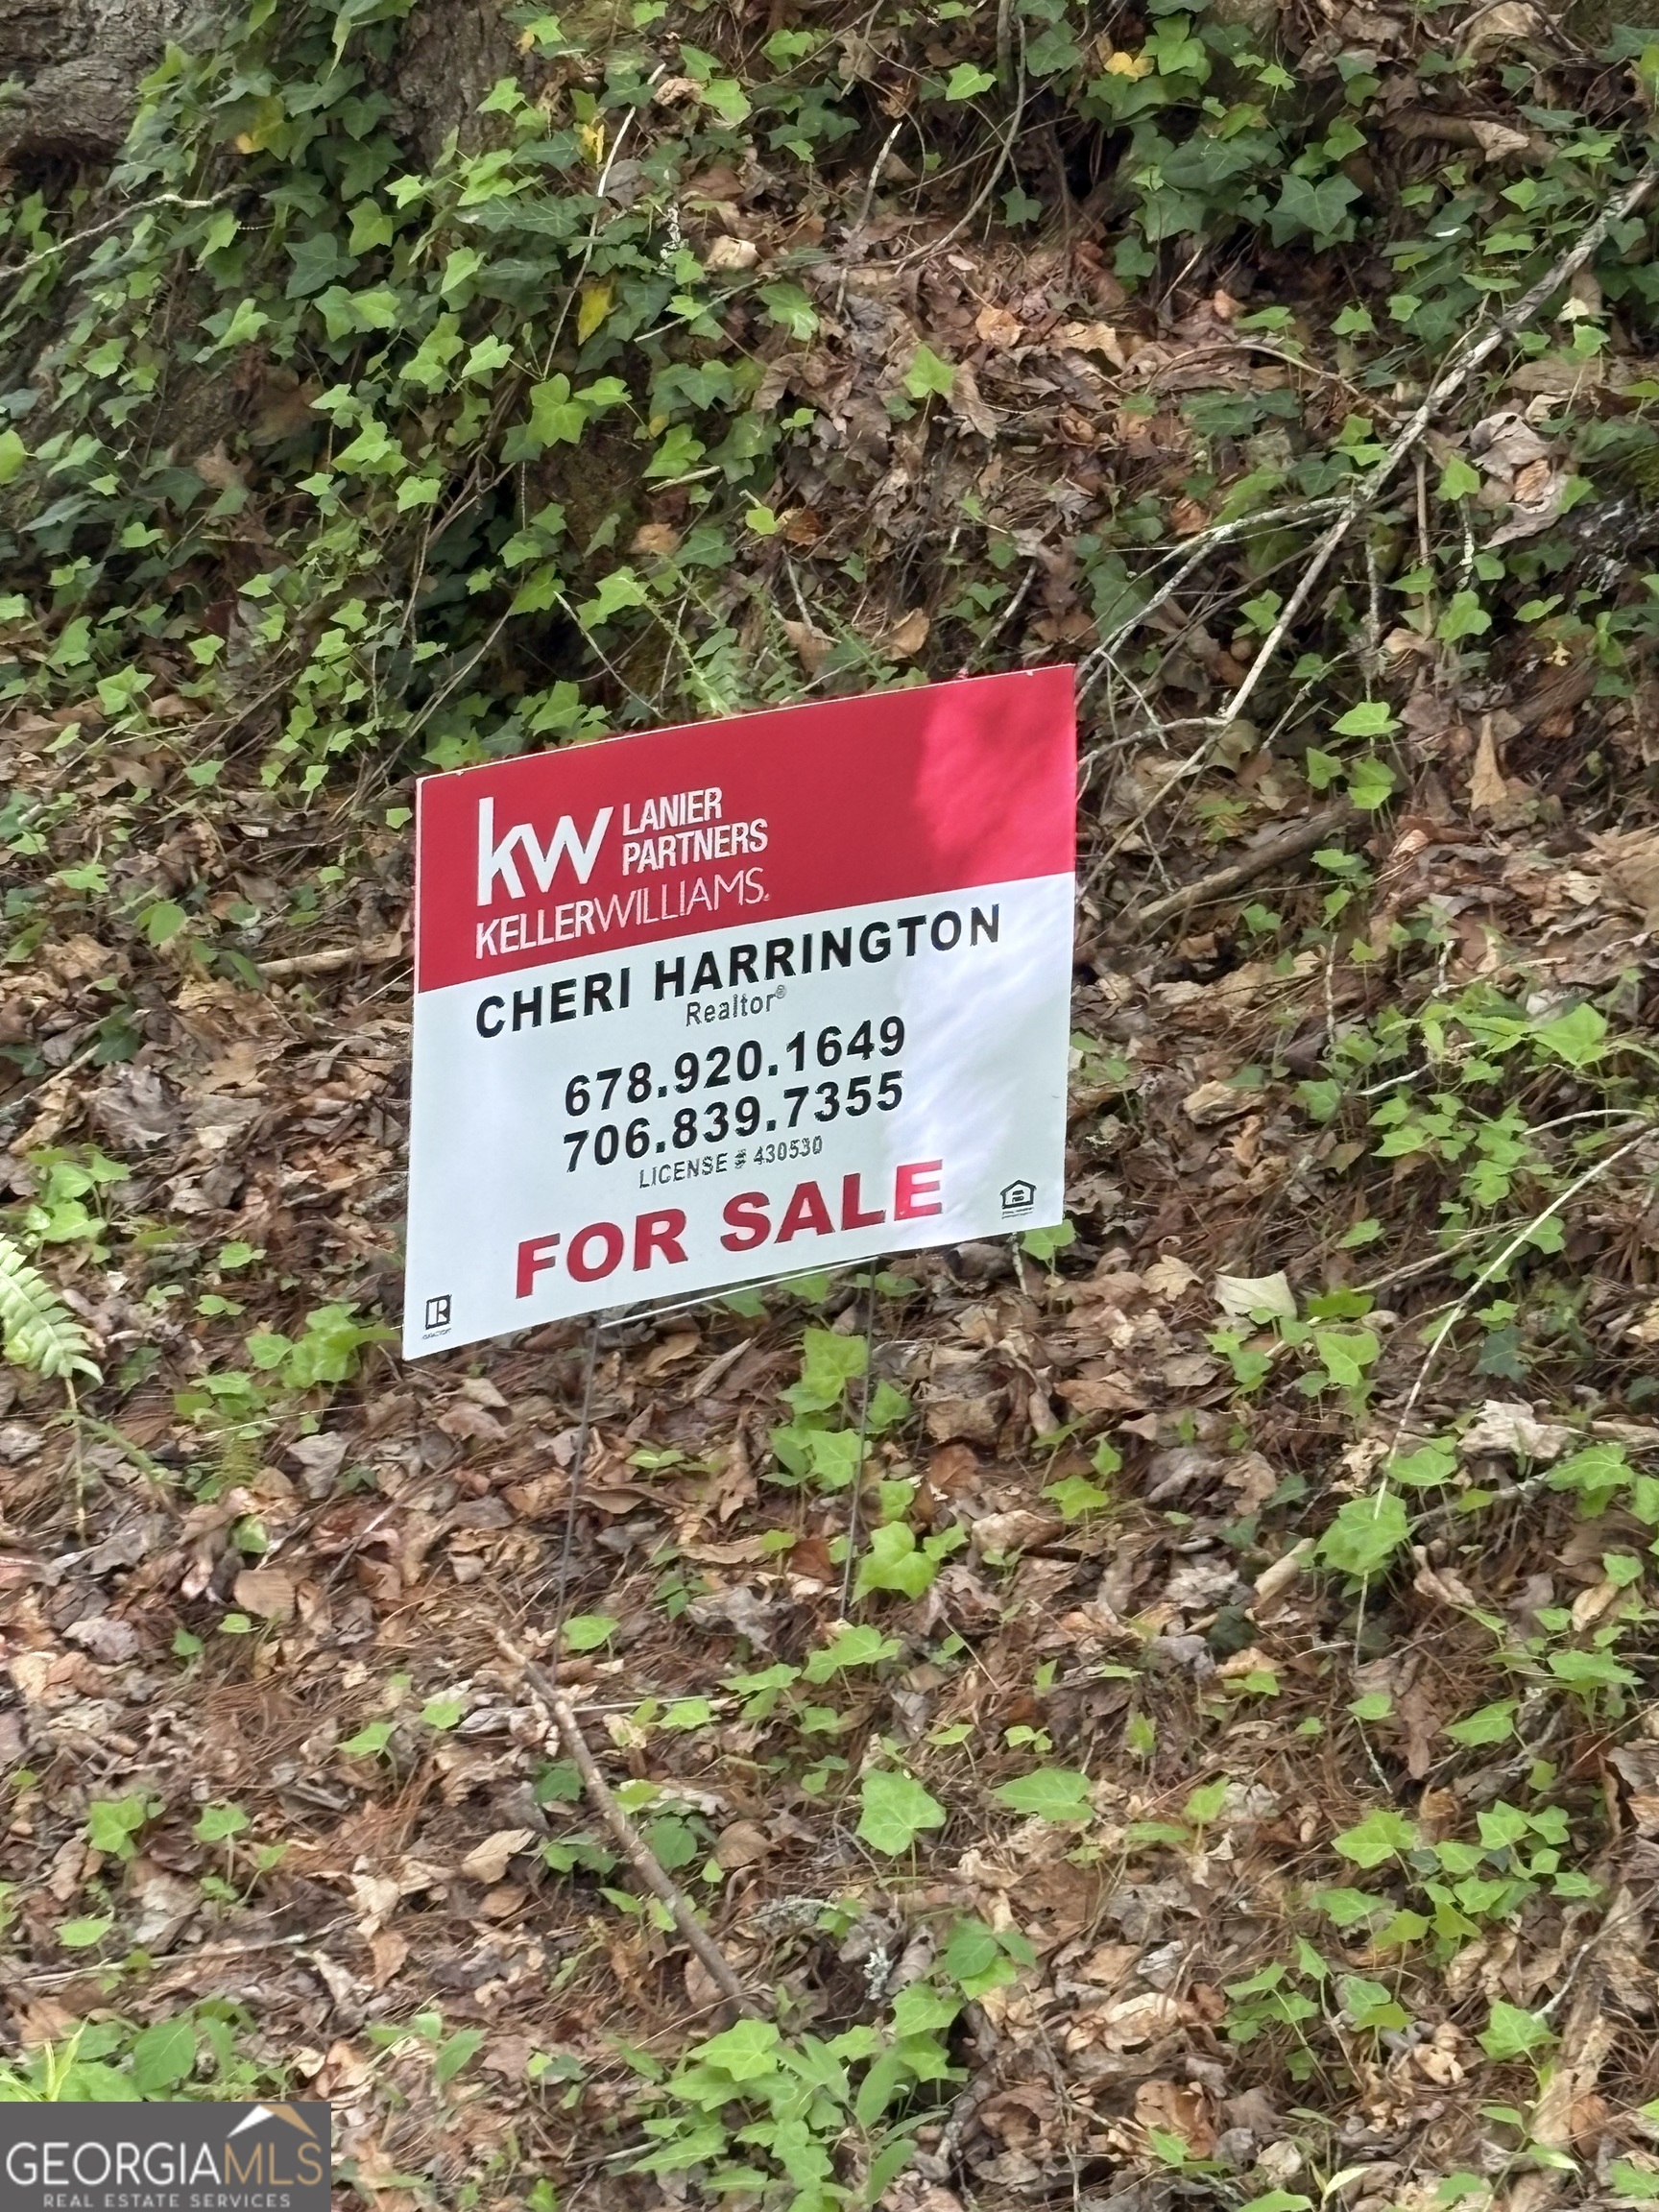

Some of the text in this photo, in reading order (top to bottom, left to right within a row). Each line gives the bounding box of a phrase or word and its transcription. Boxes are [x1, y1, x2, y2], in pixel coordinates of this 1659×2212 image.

[622, 786, 723, 836] LANIER
[622, 818, 769, 876] PARTNERS
[475, 903, 1000, 1039] CHERI HARRINGTON
[564, 1016, 905, 1117] 678.920.1649
[563, 1070, 904, 1173] 706.839.7355
[638, 1152, 729, 1190] LICENSE
[753, 1135, 824, 1166] 430530
[515, 1159, 944, 1299] FOR SALE
